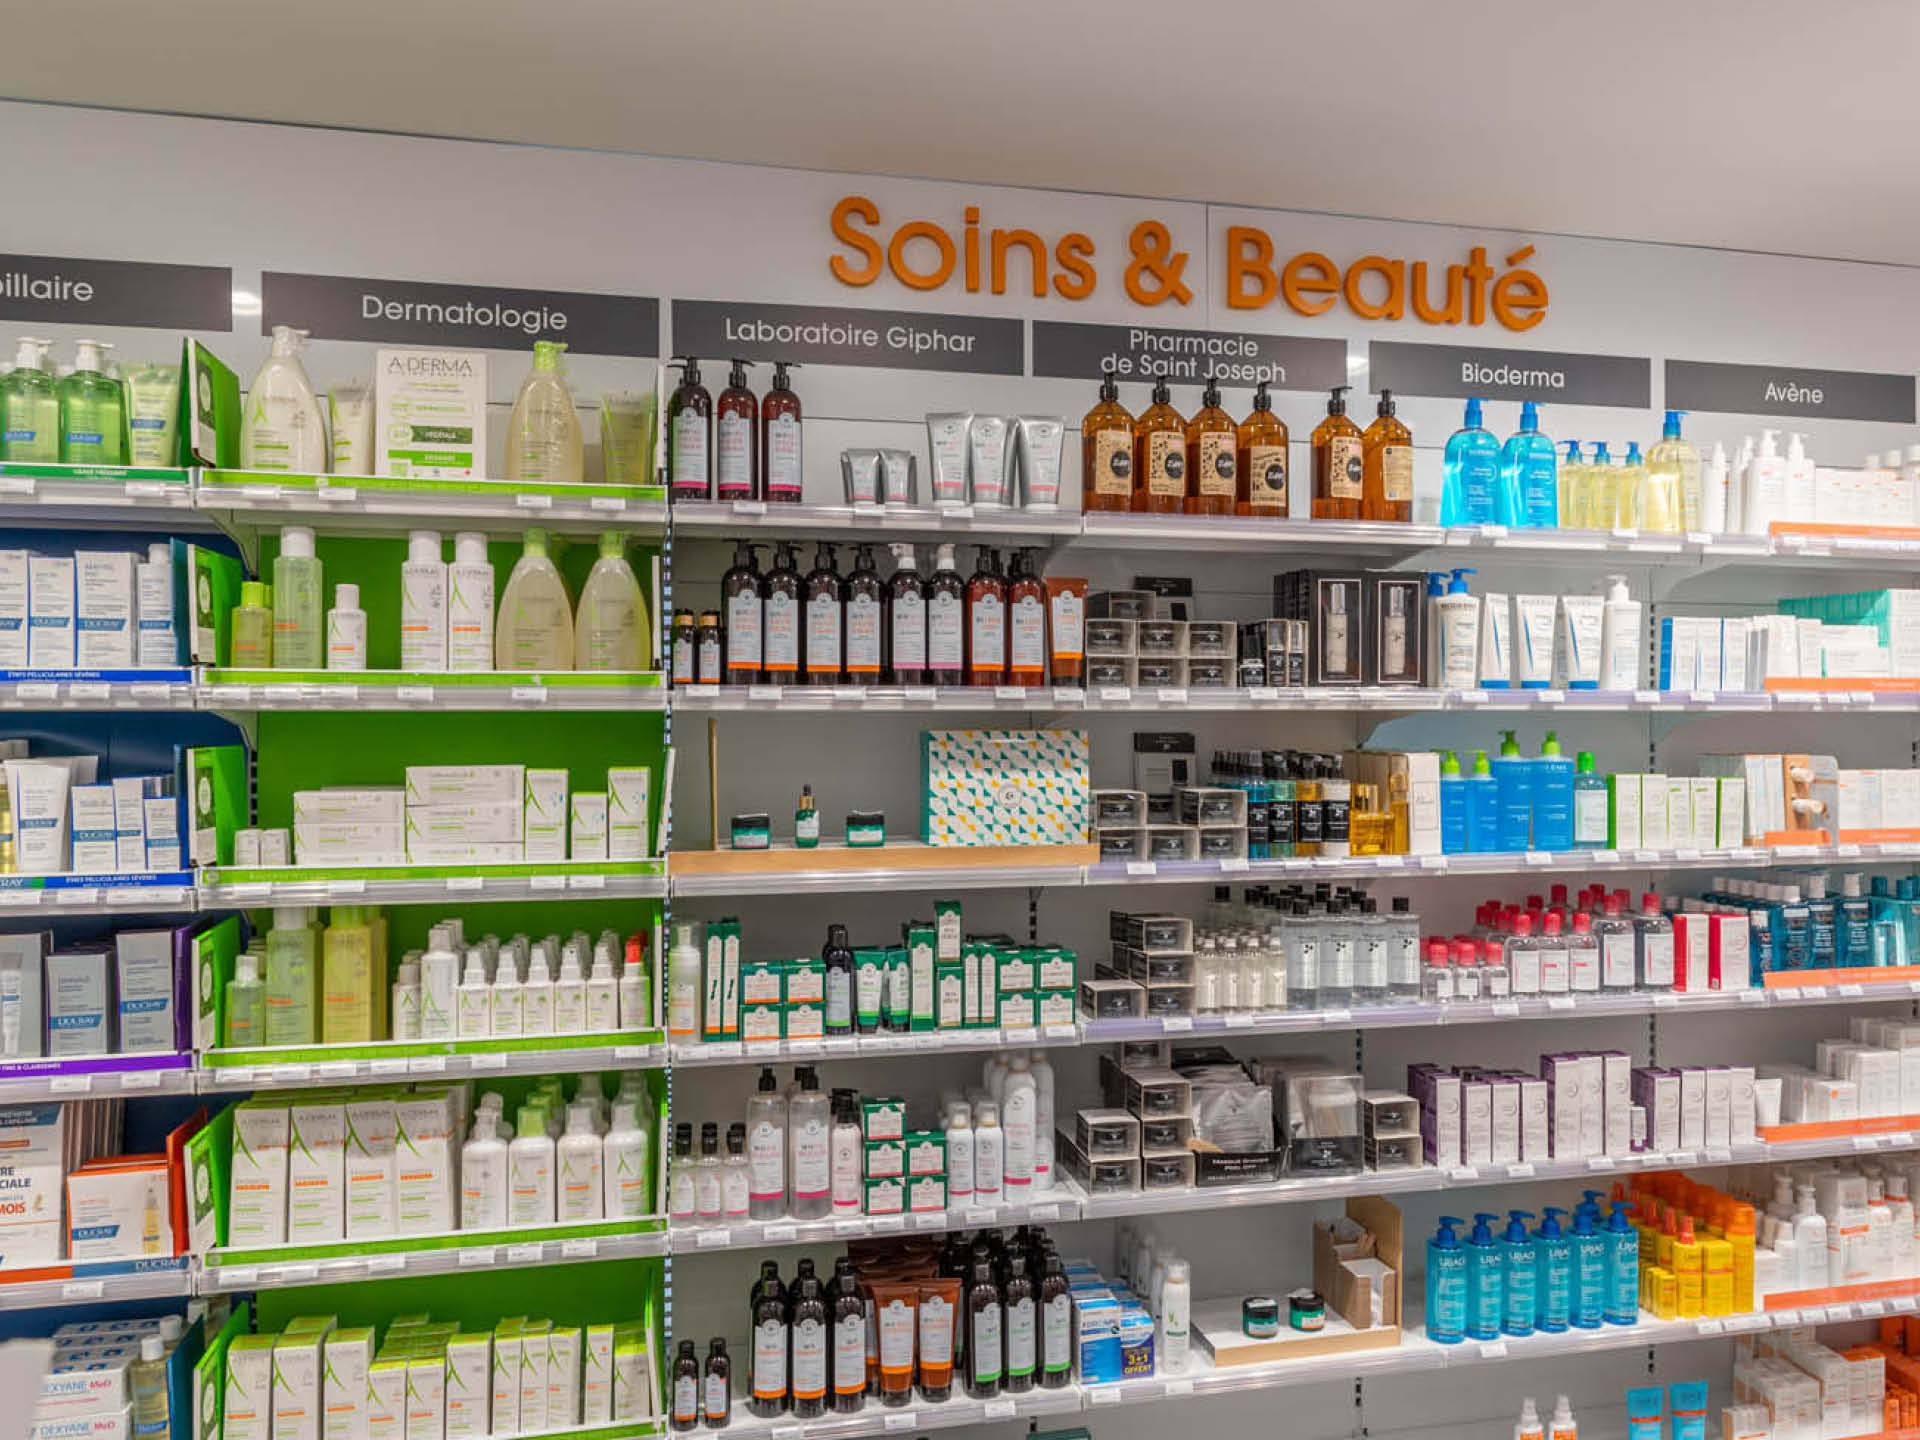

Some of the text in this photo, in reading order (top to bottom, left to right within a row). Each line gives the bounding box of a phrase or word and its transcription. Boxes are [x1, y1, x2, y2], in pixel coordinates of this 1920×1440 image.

[829, 196, 1549, 332] Soins & Beauté
[0, 271, 94, 302] illaire
[362, 294, 568, 334] Dermatologie
[726, 317, 976, 354] Laboratoire Giphar
[1130, 329, 1259, 357] Pharmacie
[1101, 352, 1287, 384] de Saint Joseph
[1461, 362, 1565, 389] Bioderma
[1763, 381, 1825, 405] Avène
